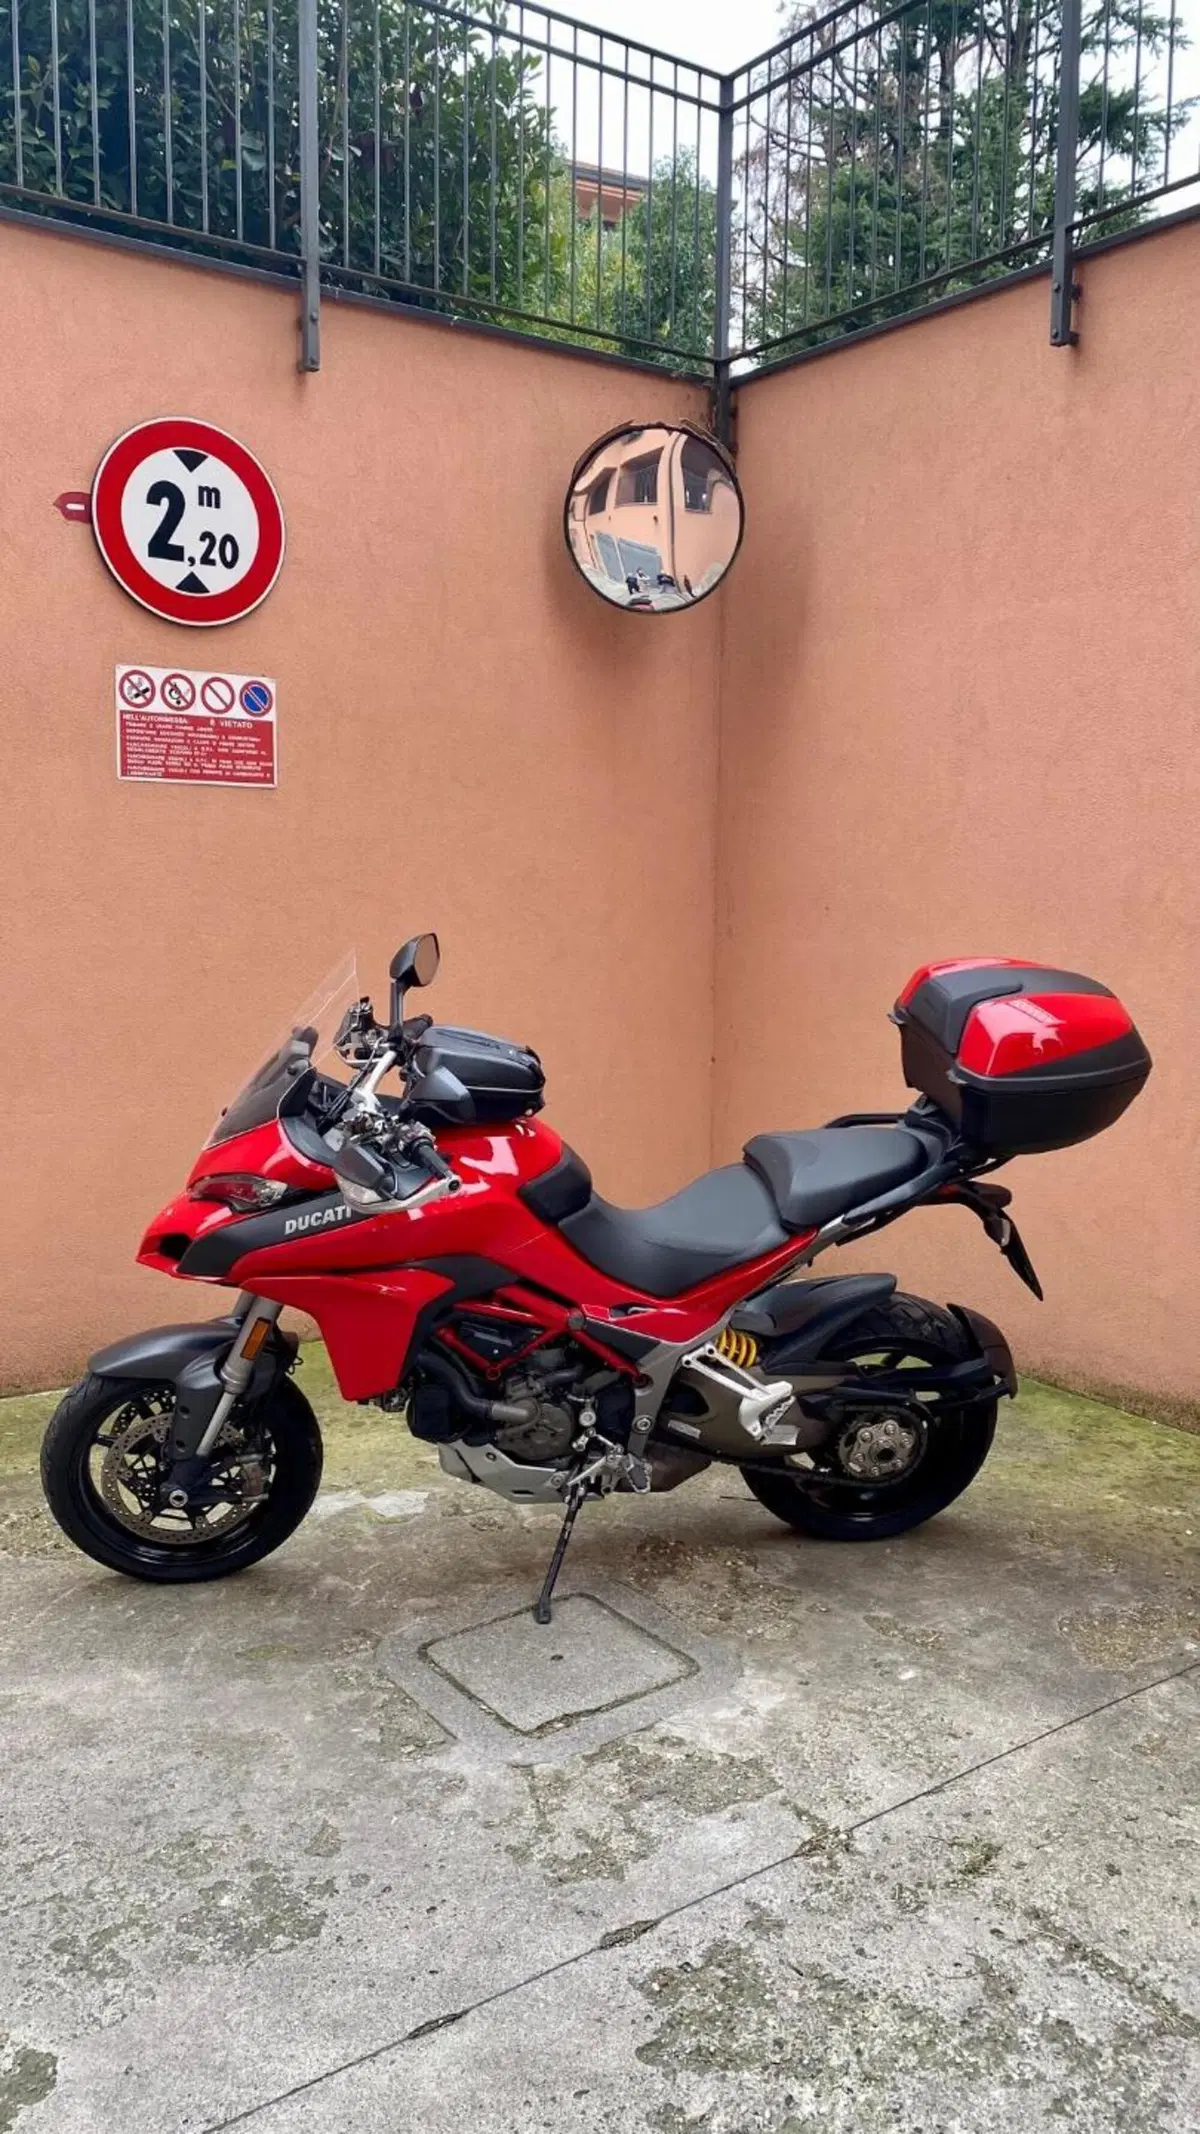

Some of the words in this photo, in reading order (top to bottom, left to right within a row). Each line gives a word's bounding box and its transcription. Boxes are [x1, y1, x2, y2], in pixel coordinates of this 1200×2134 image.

[198, 485, 221, 509] m
[220, 720, 253, 730] VIETATO
[284, 1204, 352, 1235] DUCATI
